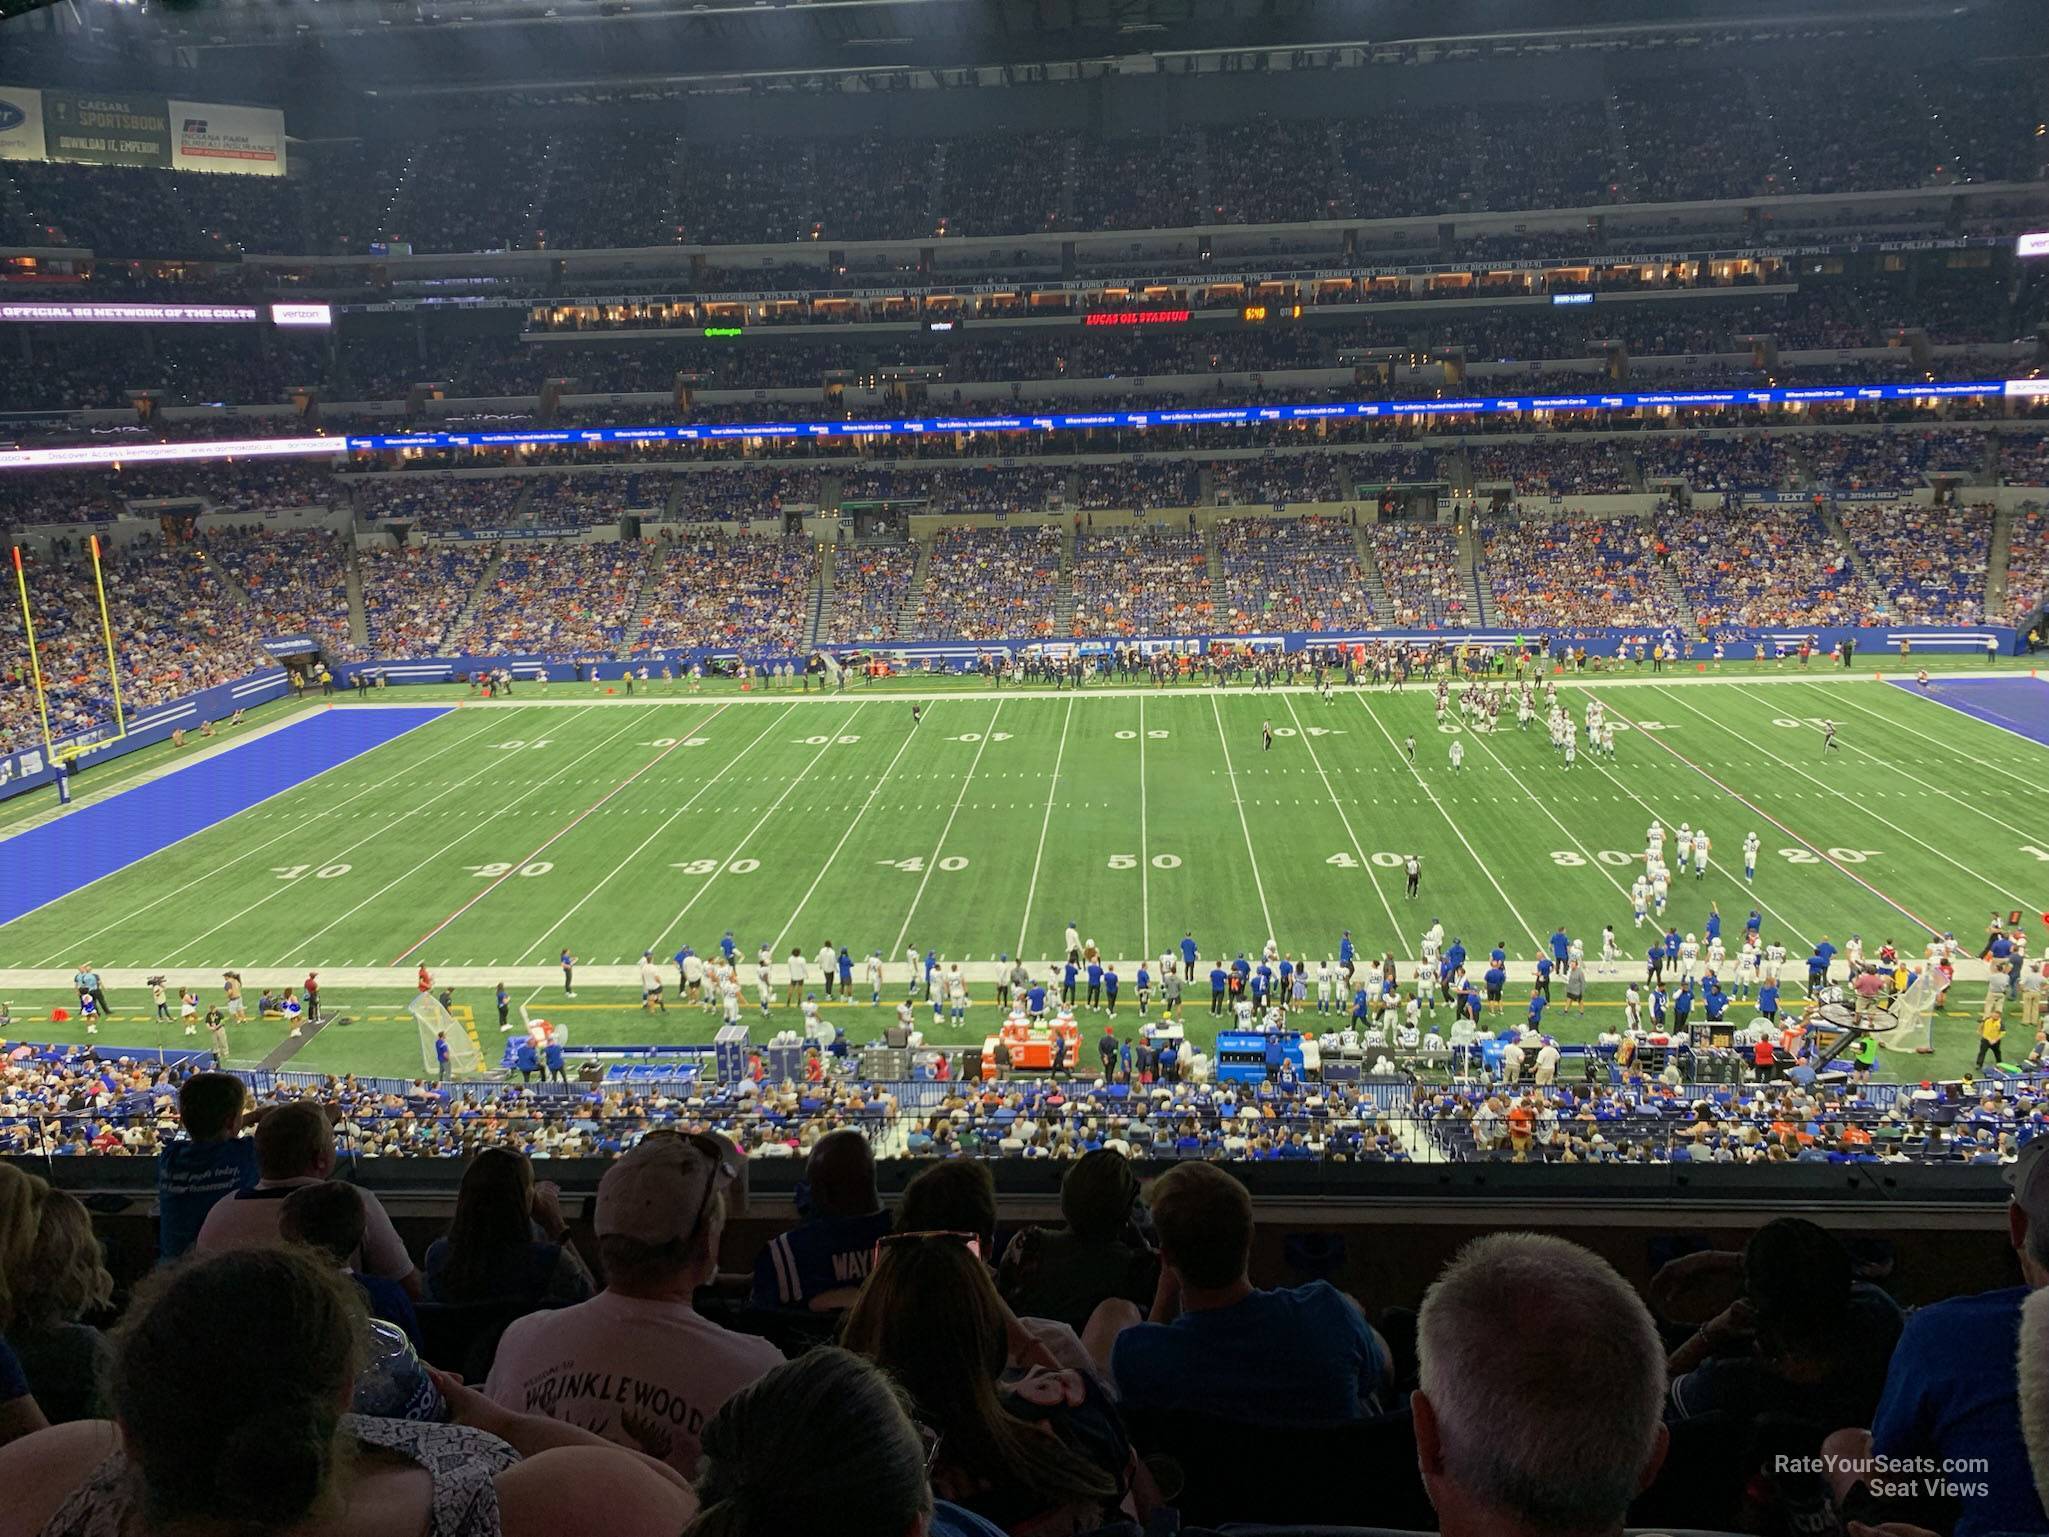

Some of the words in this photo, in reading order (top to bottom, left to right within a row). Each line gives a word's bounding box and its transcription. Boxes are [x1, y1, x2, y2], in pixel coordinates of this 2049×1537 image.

[78, 100, 130, 112] CAESARS
[79, 112, 165, 131] SPORTSBOOK
[181, 134, 220, 142] INDIANA
[223, 143, 275, 152] INSURANCE
[1471, 263, 1512, 271] DICKERSON
[1206, 274, 1242, 283] HARRISON
[3, 307, 71, 317] OFFICIAL
[94, 308, 164, 318] NETWORK
[166, 308, 183, 318] OF
[185, 309, 212, 319] THE
[213, 309, 256, 319] COLTS
[282, 310, 319, 319] verizon
[1086, 313, 1118, 326] LUCAS
[1121, 312, 1138, 324] OIL
[1139, 310, 1190, 324] STADIUM
[893, 855, 970, 873] 40
[1106, 853, 1184, 871] 50
[1325, 851, 1412, 869] 40
[1553, 849, 1633, 866] 30
[1778, 847, 1868, 864] 20
[276, 863, 353, 880] 10
[472, 862, 556, 878] 20
[682, 858, 761, 875] 30
[831, 1250, 872, 1281] WAY
[525, 1371, 704, 1435] WRINKLEWOOD
